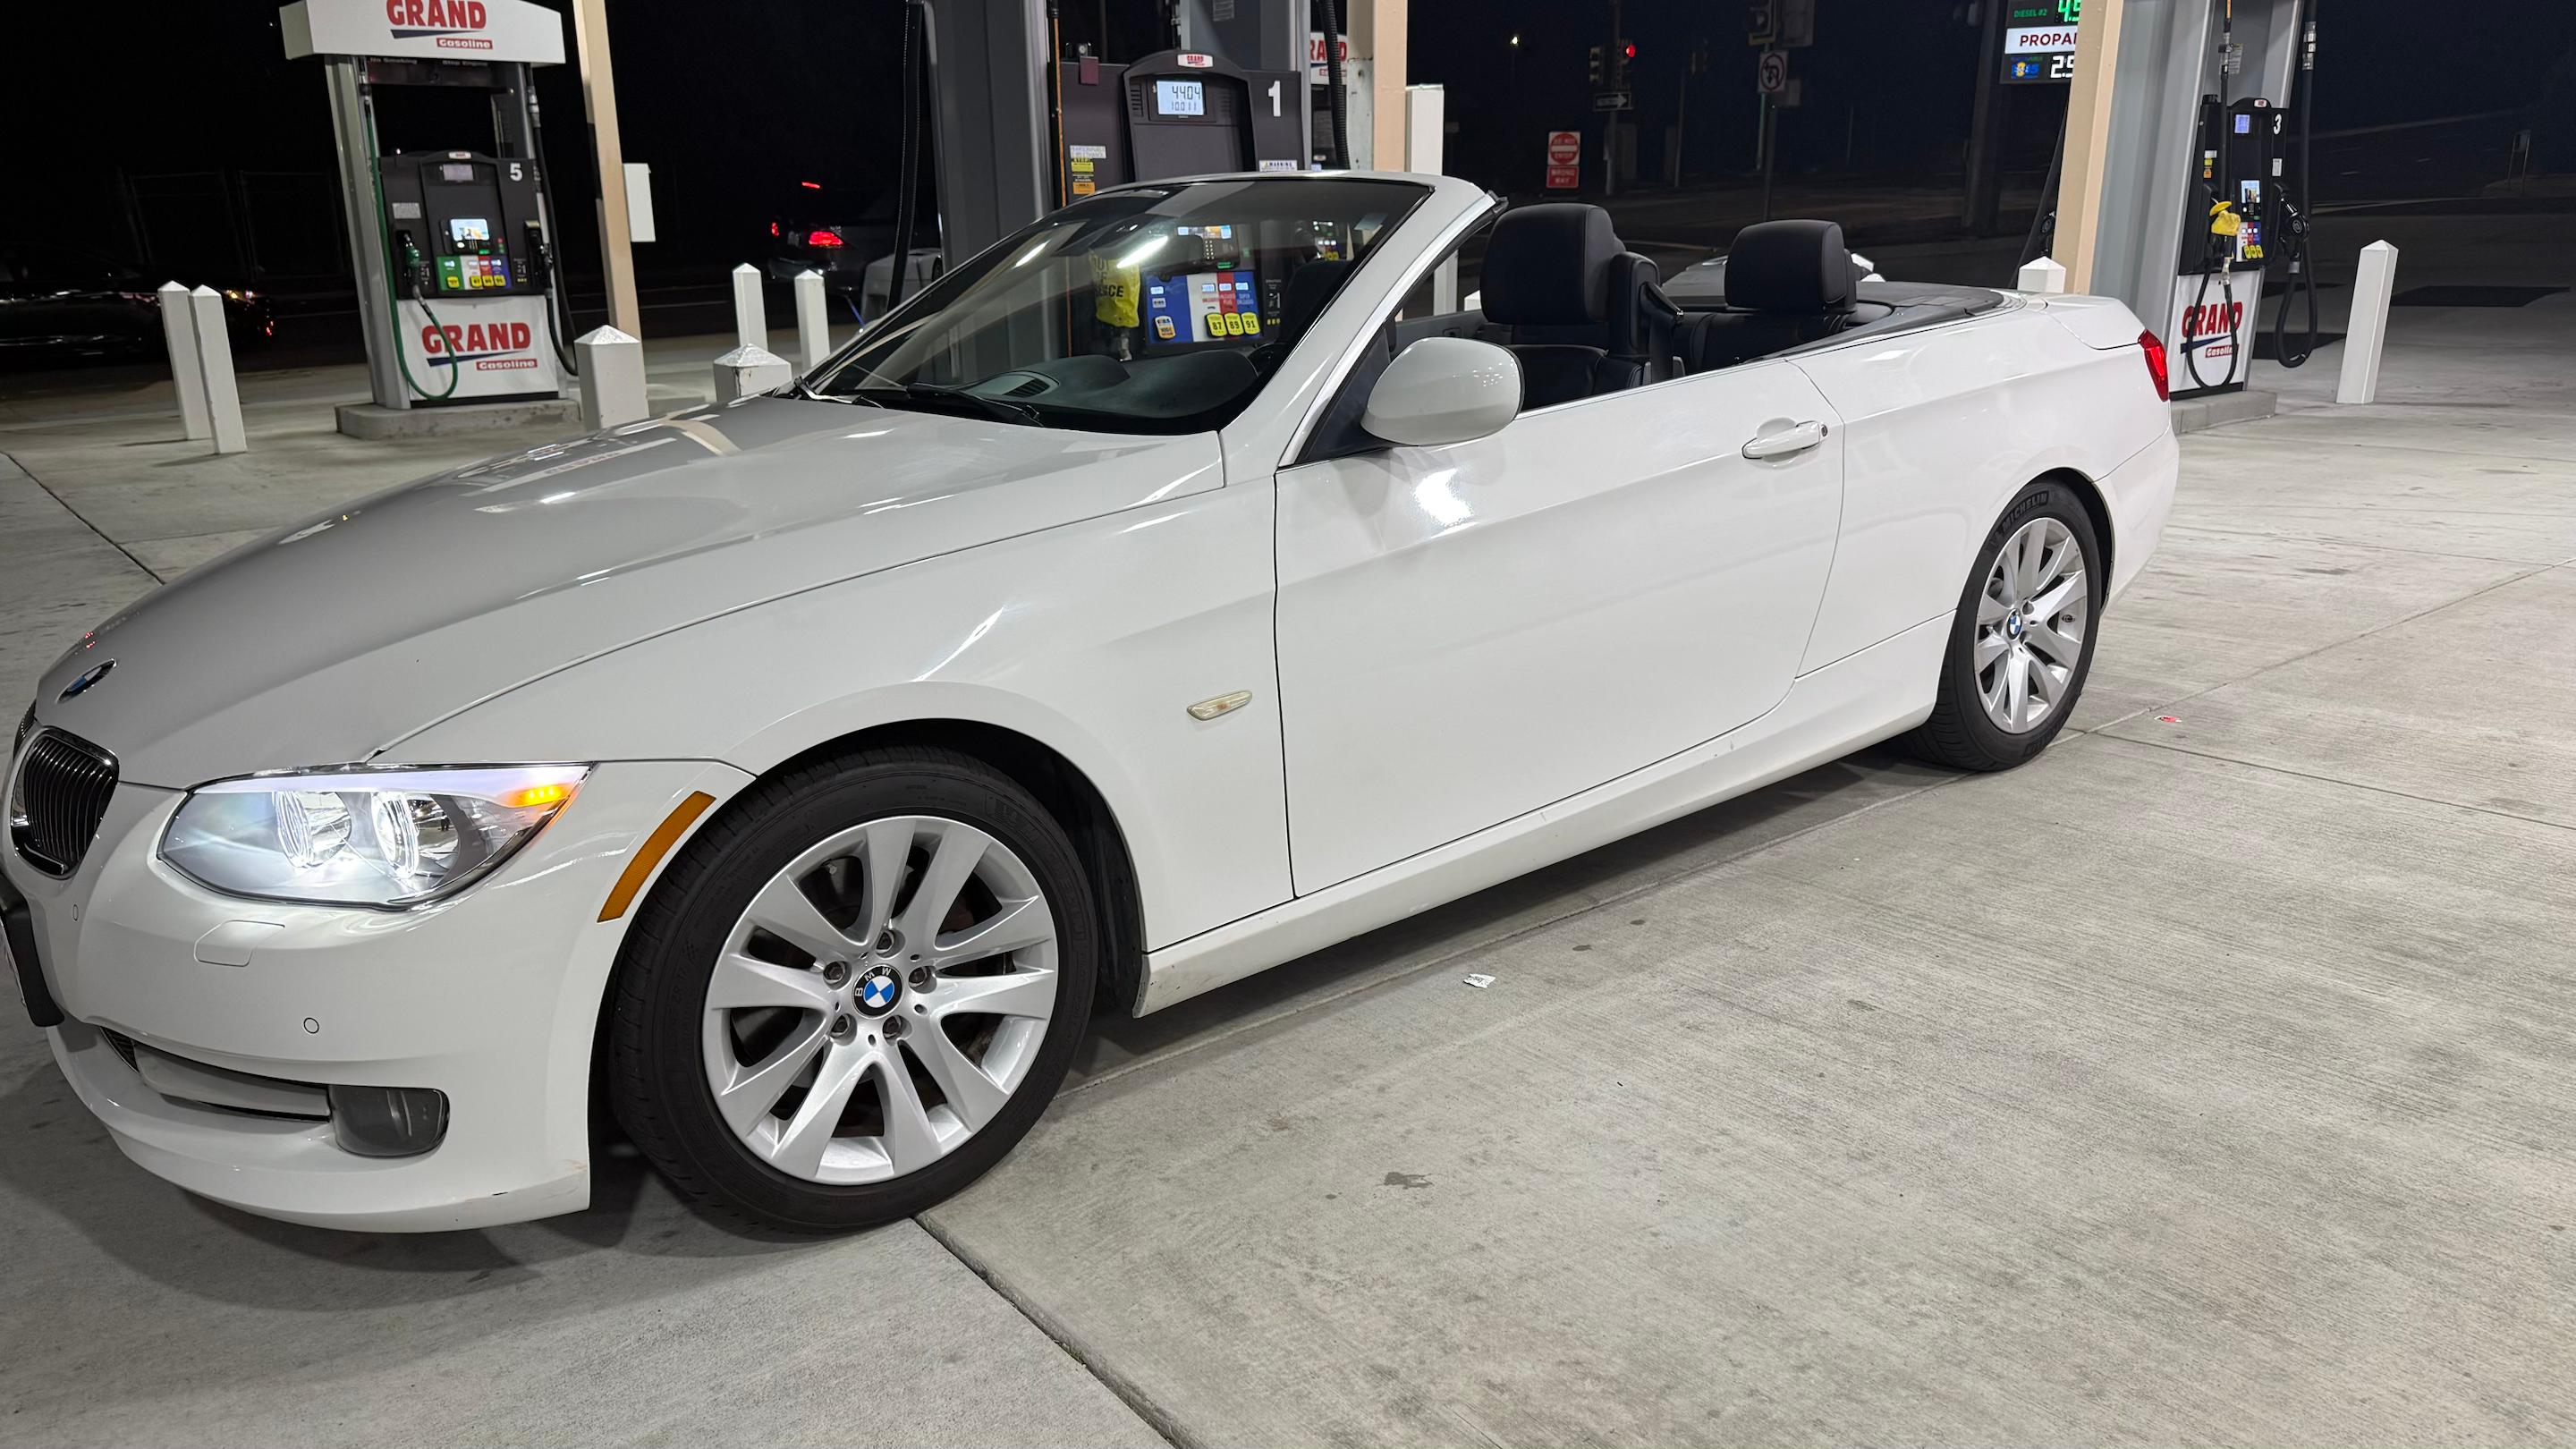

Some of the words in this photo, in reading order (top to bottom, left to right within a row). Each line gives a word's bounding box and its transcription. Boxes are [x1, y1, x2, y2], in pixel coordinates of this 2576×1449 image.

[386, 0, 487, 29] GRAND
[2013, 9, 2037, 18] DIESEL
[438, 38, 491, 49] Gasoline
[2020, 32, 2077, 47] PROPA
[1268, 80, 1281, 117] 1
[2273, 114, 2282, 135] 3
[510, 163, 523, 182] 5
[1212, 321, 1223, 330] 87
[1245, 320, 1256, 328] 91
[421, 322, 530, 354] GRAND
[479, 359, 536, 369] Gasoline
[2002, 492, 2048, 532] MICHELIN
[854, 967, 892, 997] BMW
